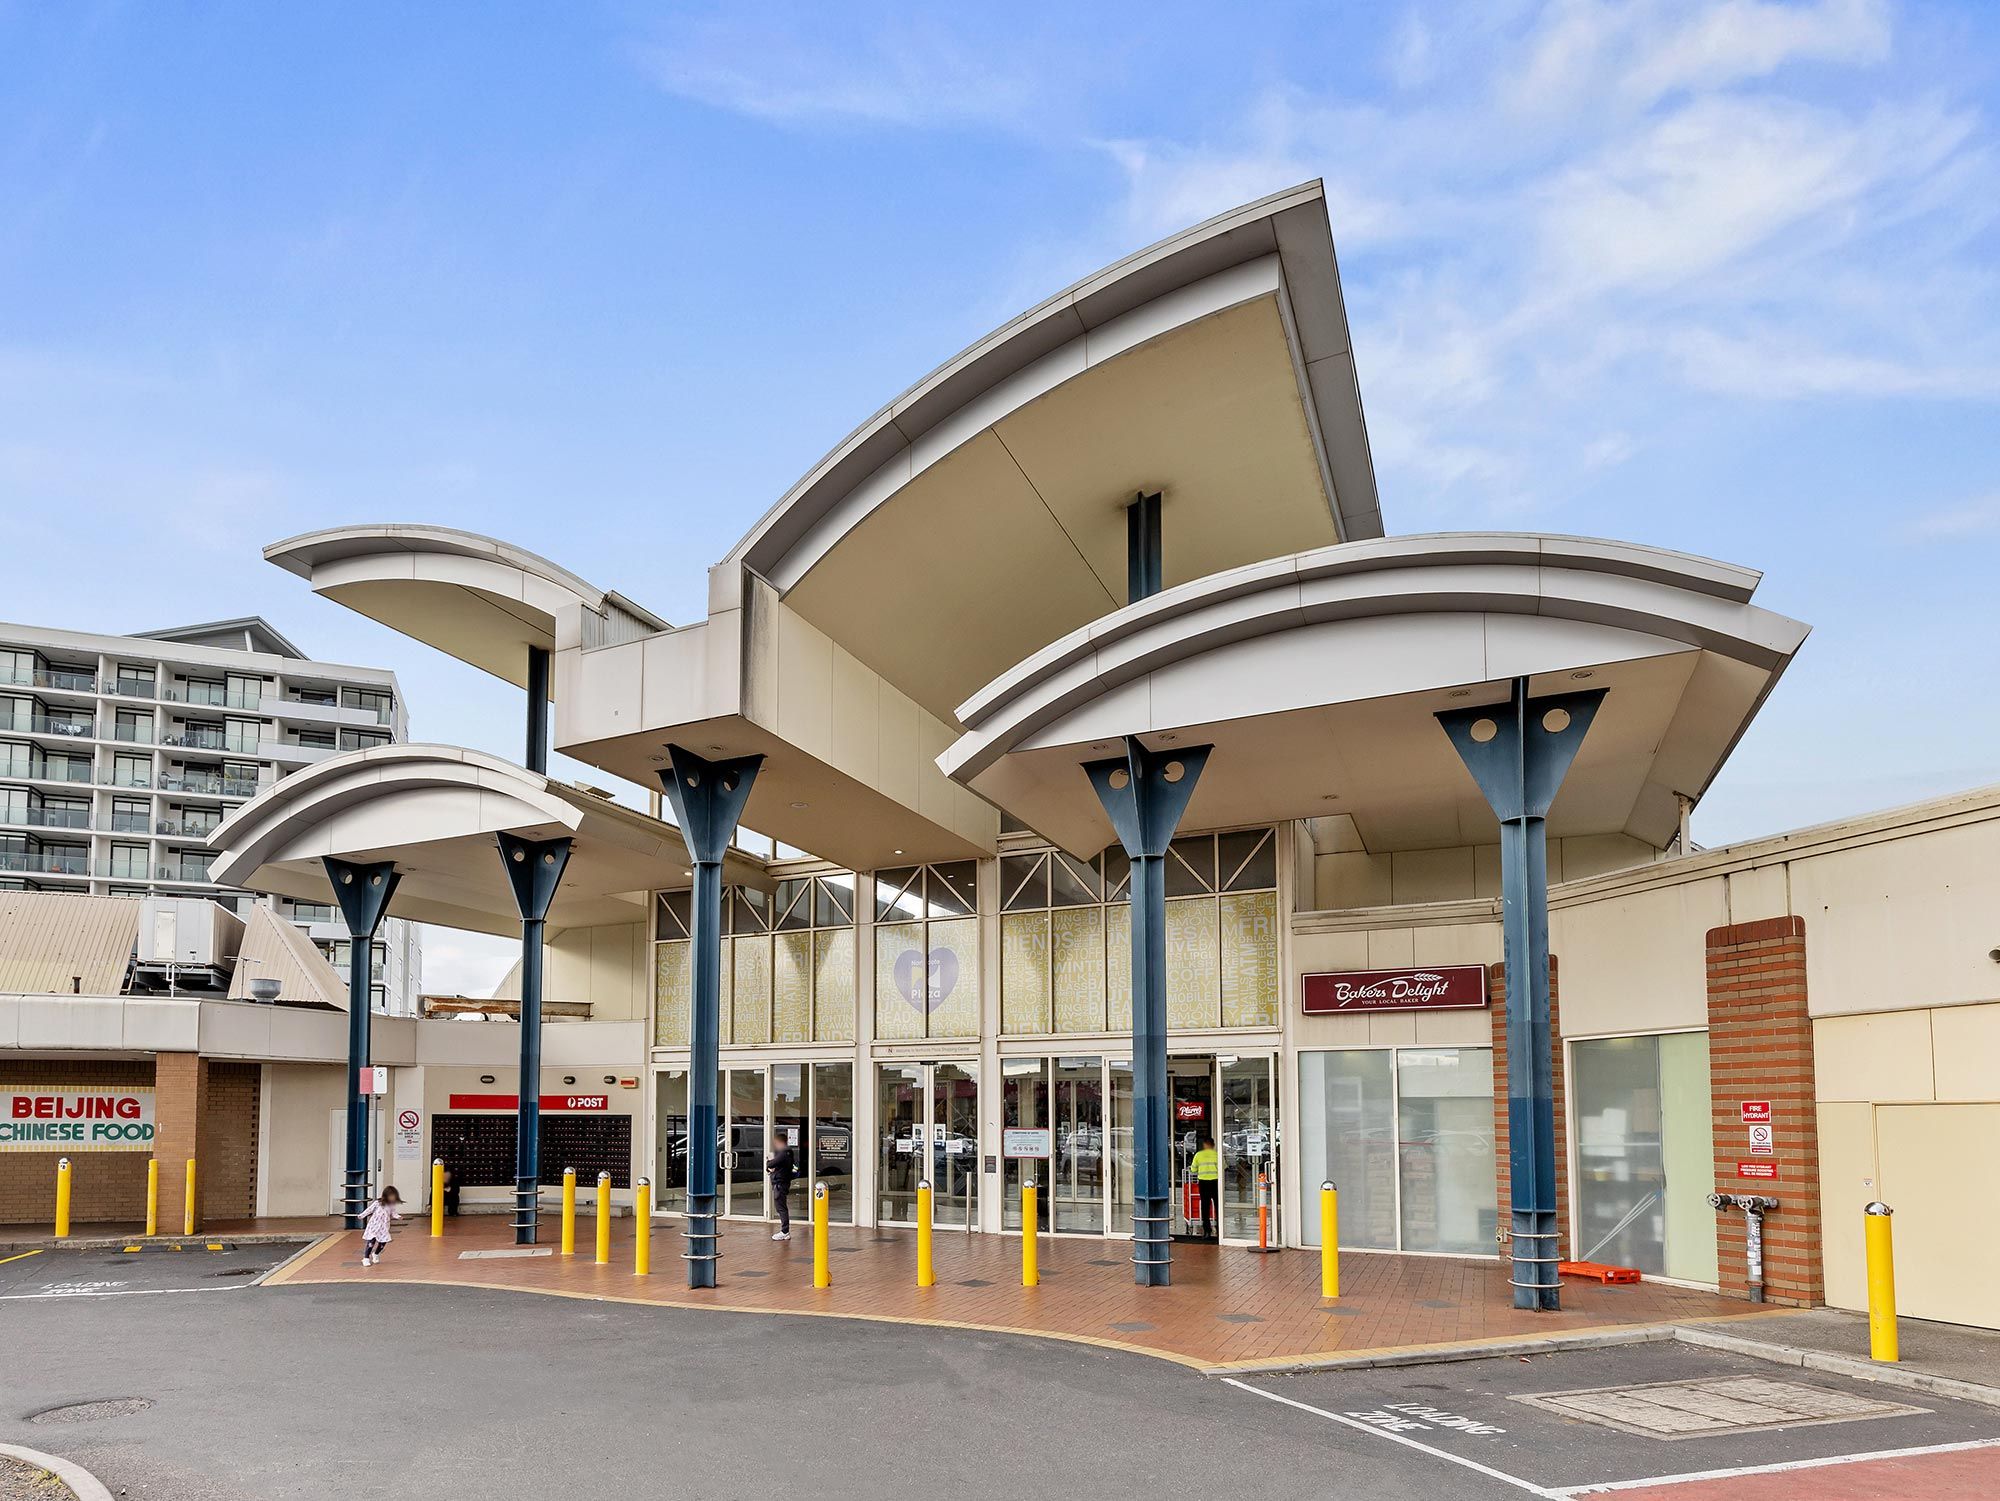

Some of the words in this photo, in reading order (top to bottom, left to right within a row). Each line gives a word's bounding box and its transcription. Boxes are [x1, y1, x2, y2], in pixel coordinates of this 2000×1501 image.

[912, 989, 940, 998] Plza
[1334, 982, 1387, 1005] Bakers
[1392, 980, 1448, 1002] Delight
[12, 1096, 141, 1119] BEIJING
[577, 1097, 604, 1108] POST
[0, 1123, 85, 1141] CHINESE
[92, 1123, 155, 1141] FOOD
[1343, 1410, 1434, 1432] ZONE
[1382, 1402, 1507, 1435] LOADING
